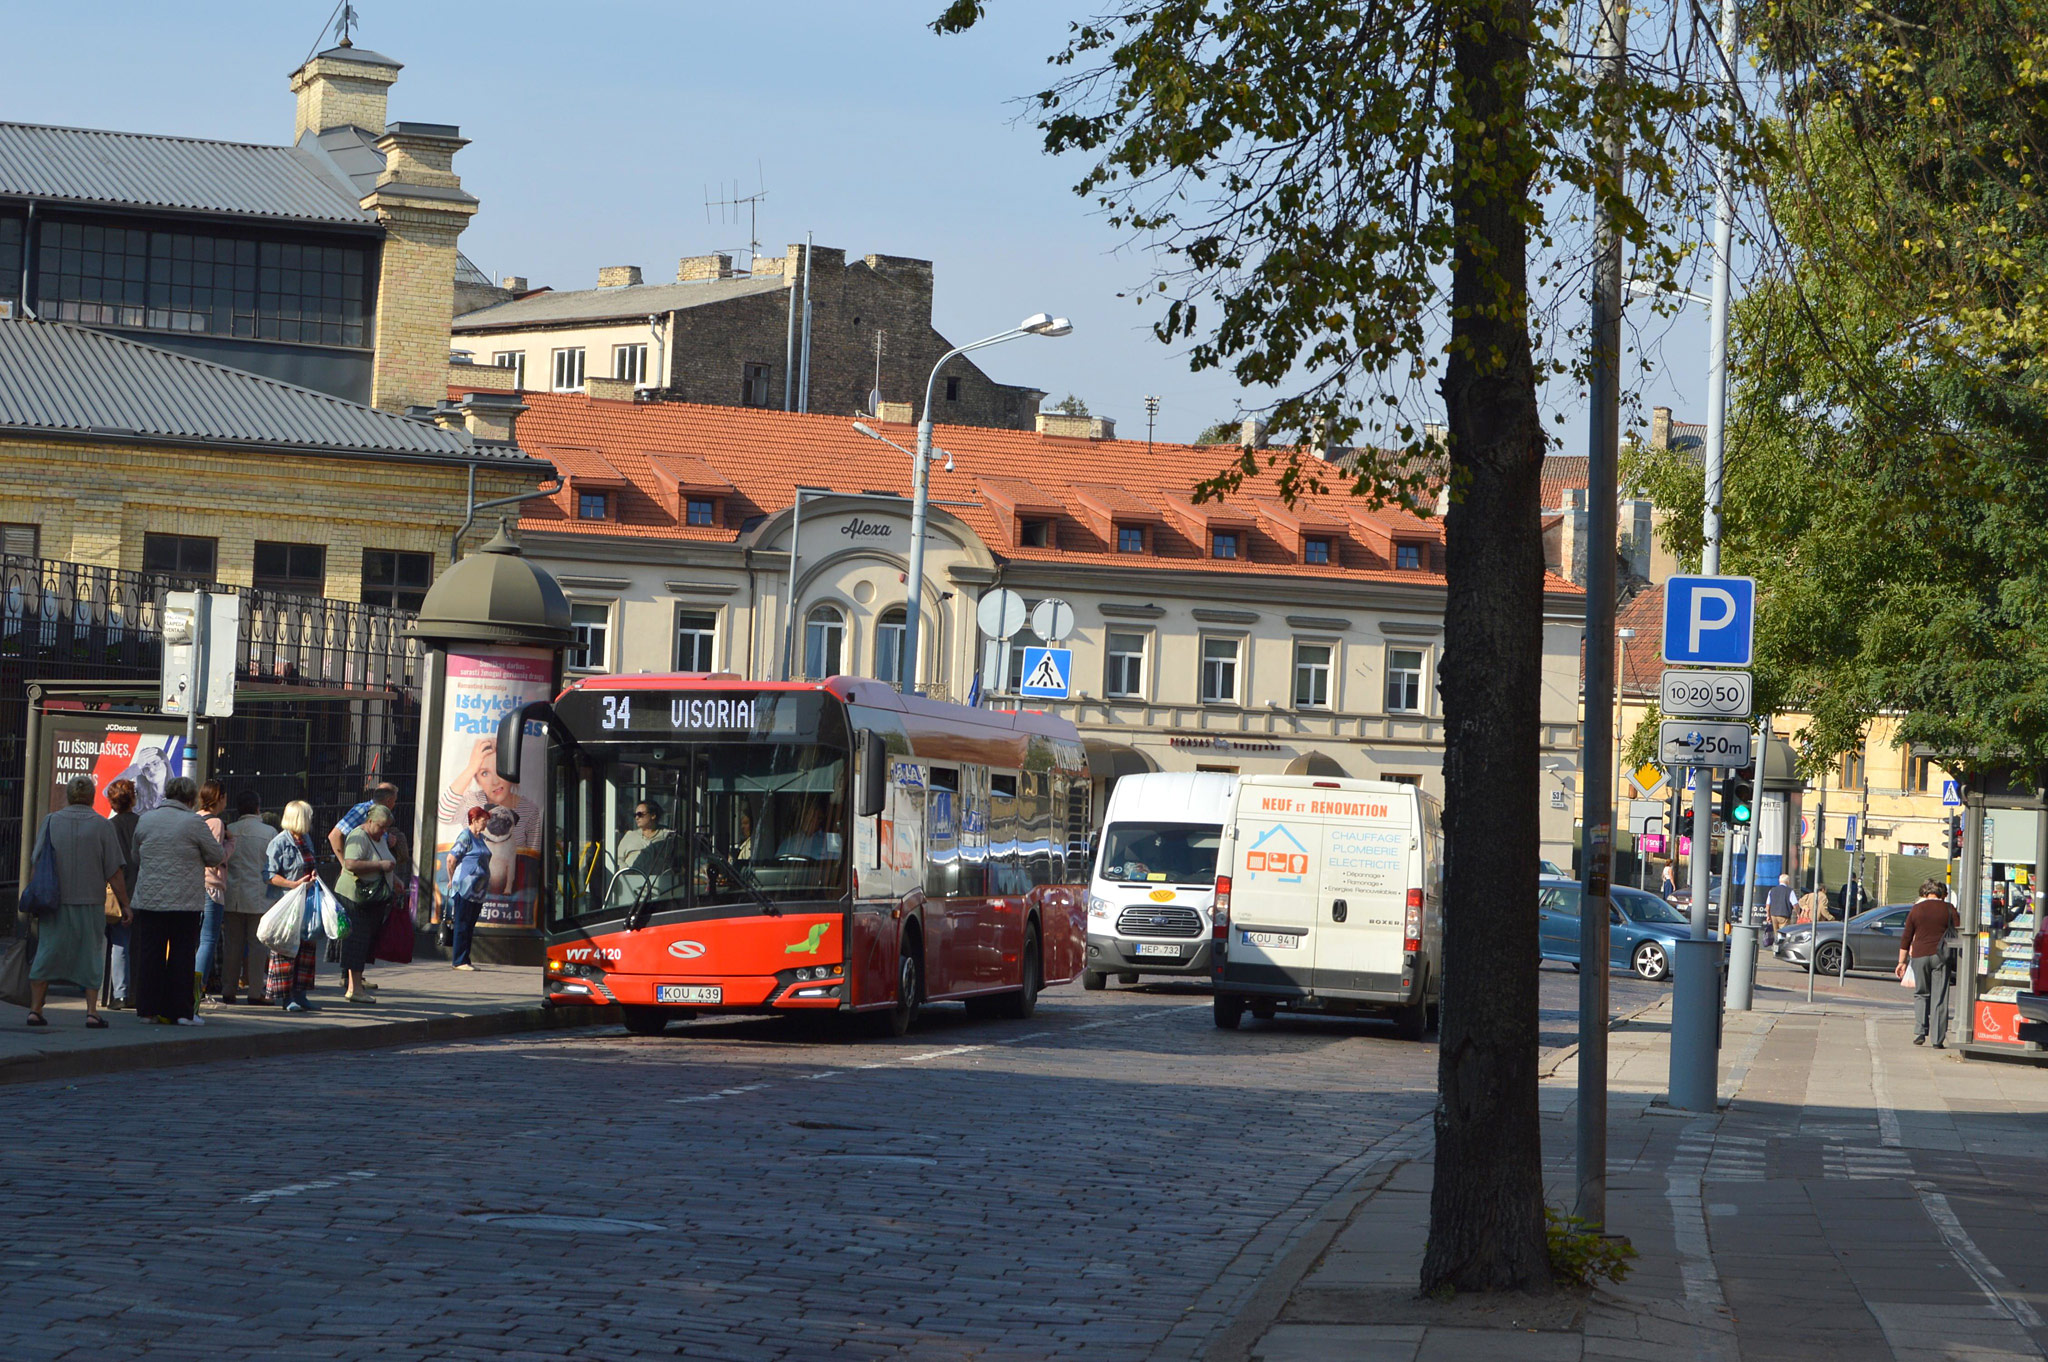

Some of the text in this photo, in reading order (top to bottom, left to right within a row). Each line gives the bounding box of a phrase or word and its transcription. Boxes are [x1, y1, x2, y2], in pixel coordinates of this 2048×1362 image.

[841, 518, 892, 539] Alexa
[1688, 587, 1736, 653] P
[1671, 686, 1739, 702] 10 20 50
[602, 696, 755, 729] 34 VISORIAI
[58, 740, 70, 753] TU
[1170, 737, 1210, 748] PEGASAS
[56, 756, 89, 770] KAI ESI
[1262, 797, 1388, 817] NEUF ET RENOVATION
[1331, 831, 1402, 843] CHAUFFAGE
[1332, 844, 1398, 856] PLOMBERIE
[1329, 858, 1400, 870] ELECTRICITE
[1249, 933, 1296, 945] KOU 941
[593, 948, 621, 960] 4120
[1141, 945, 1179, 954] HEP 732
[664, 988, 690, 998] KOU
[697, 988, 719, 999] 439
